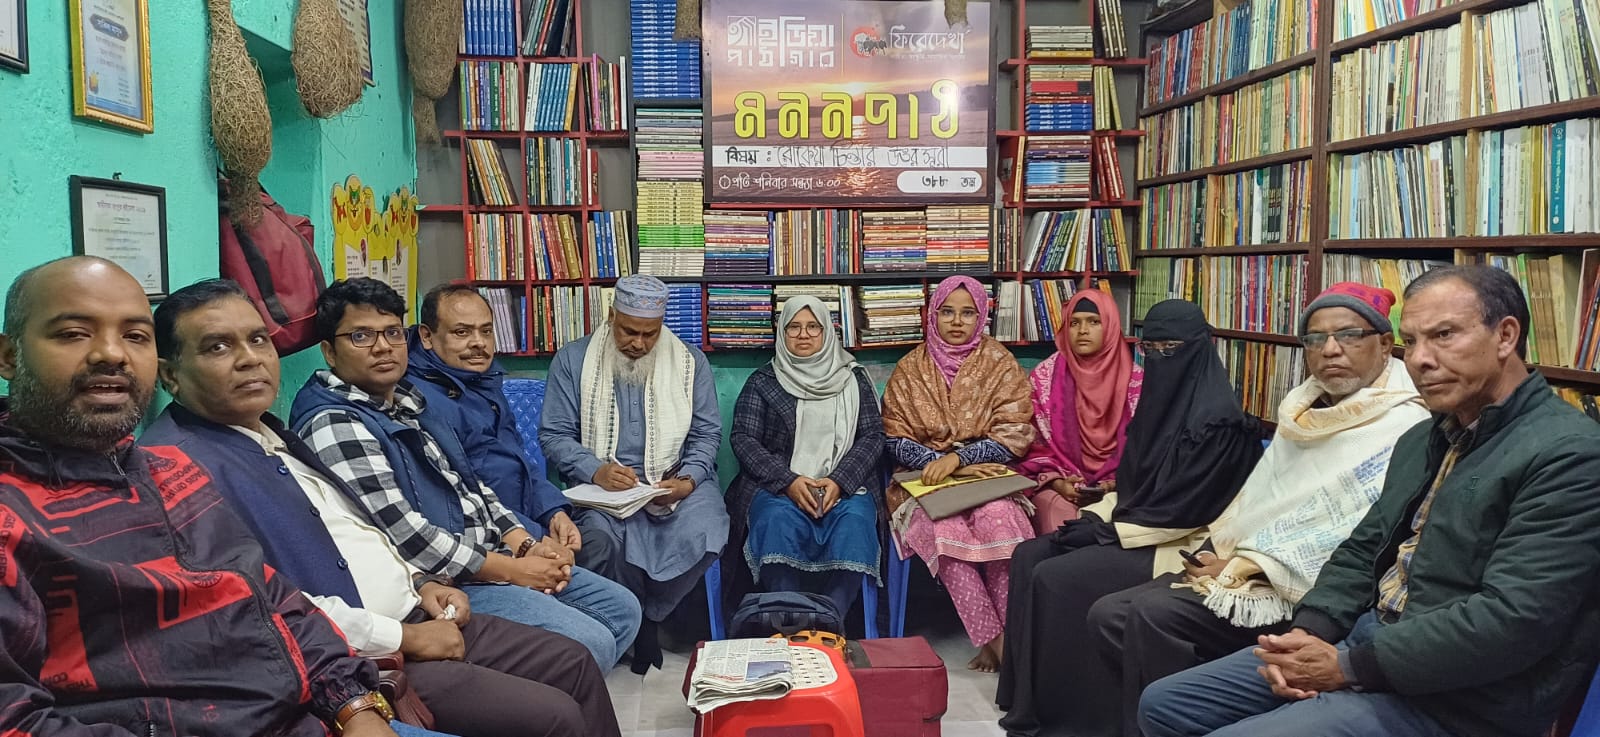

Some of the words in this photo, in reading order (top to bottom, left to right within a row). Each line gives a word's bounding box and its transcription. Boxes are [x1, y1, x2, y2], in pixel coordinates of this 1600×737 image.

[733, 79, 960, 139] মননপাঠ
[725, 147, 759, 165] বিষয়
[732, 171, 751, 190] প্রতি
[753, 171, 788, 191] শনিবার
[789, 176, 813, 190] সন্ধ্যা
